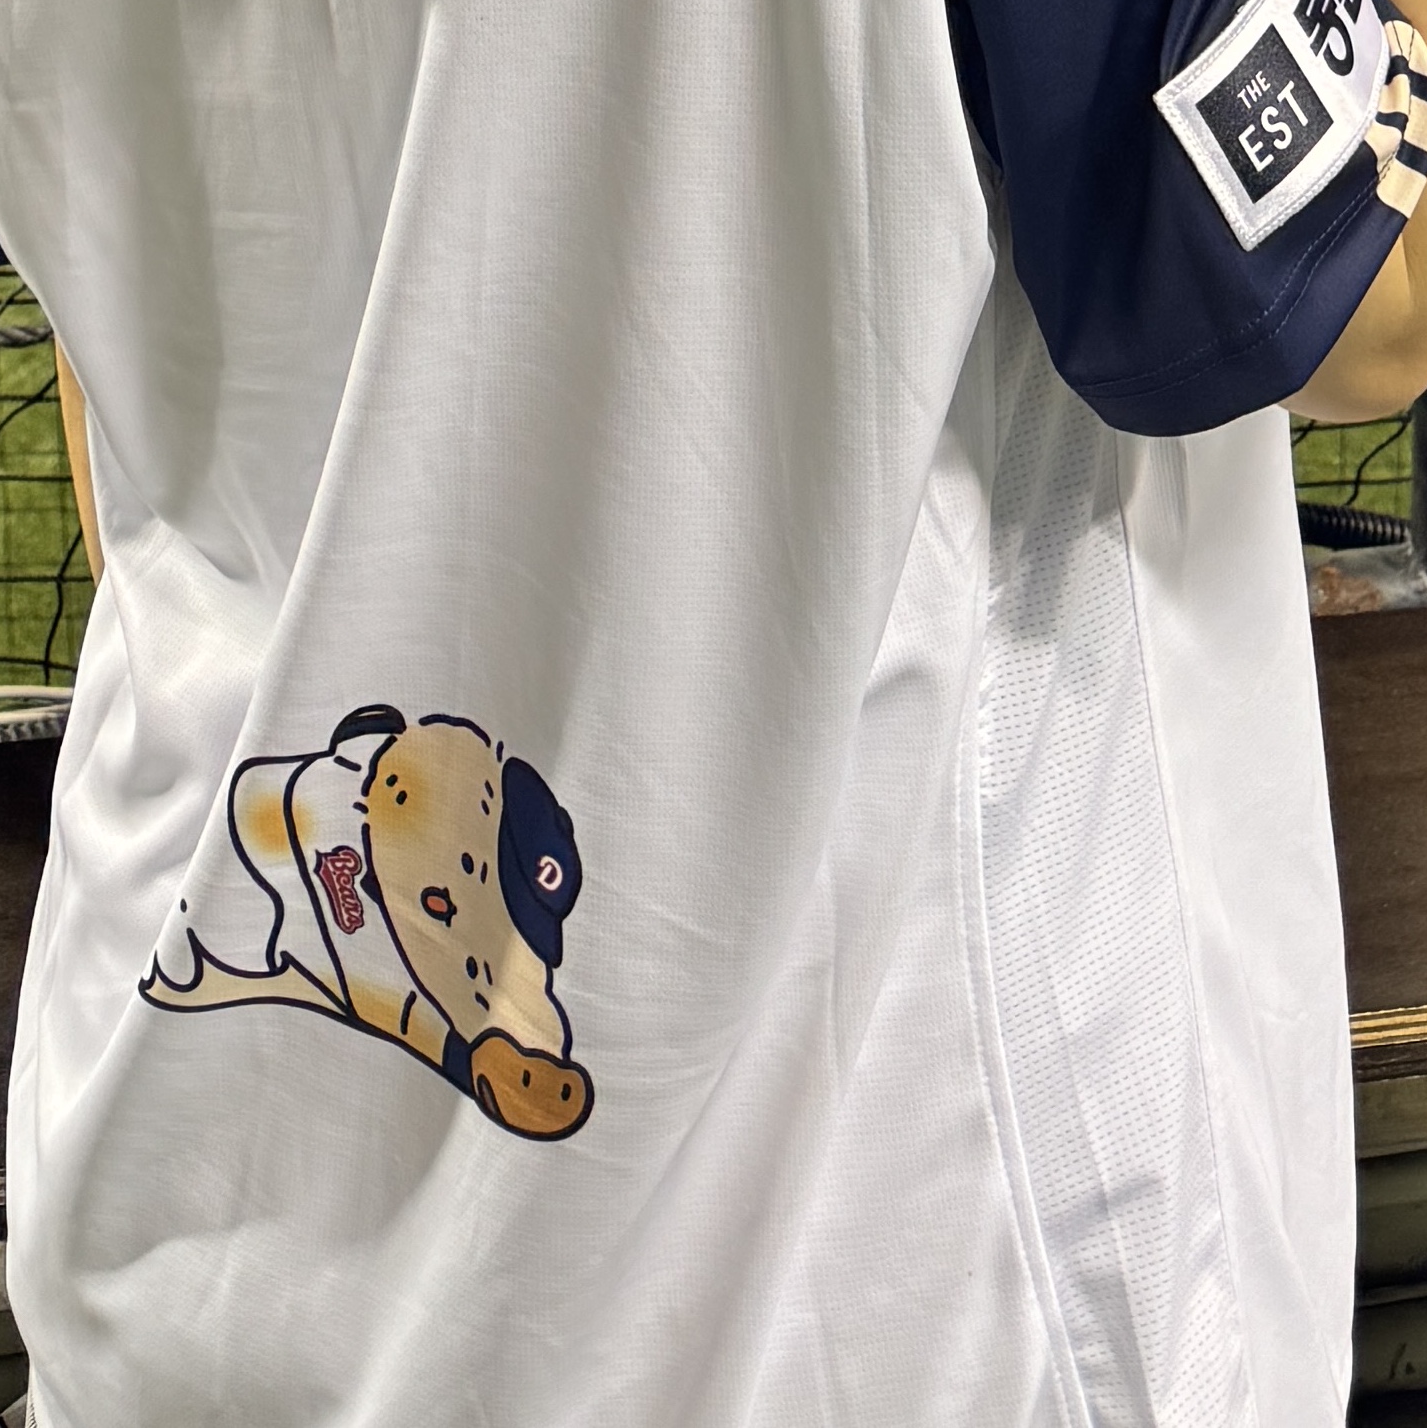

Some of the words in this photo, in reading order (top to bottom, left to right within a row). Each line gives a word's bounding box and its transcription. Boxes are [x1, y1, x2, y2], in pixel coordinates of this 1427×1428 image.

[1236, 70, 1271, 109] THE
[1238, 80, 1309, 173] EST
[317, 847, 364, 932] Bears
[536, 854, 564, 892] D
